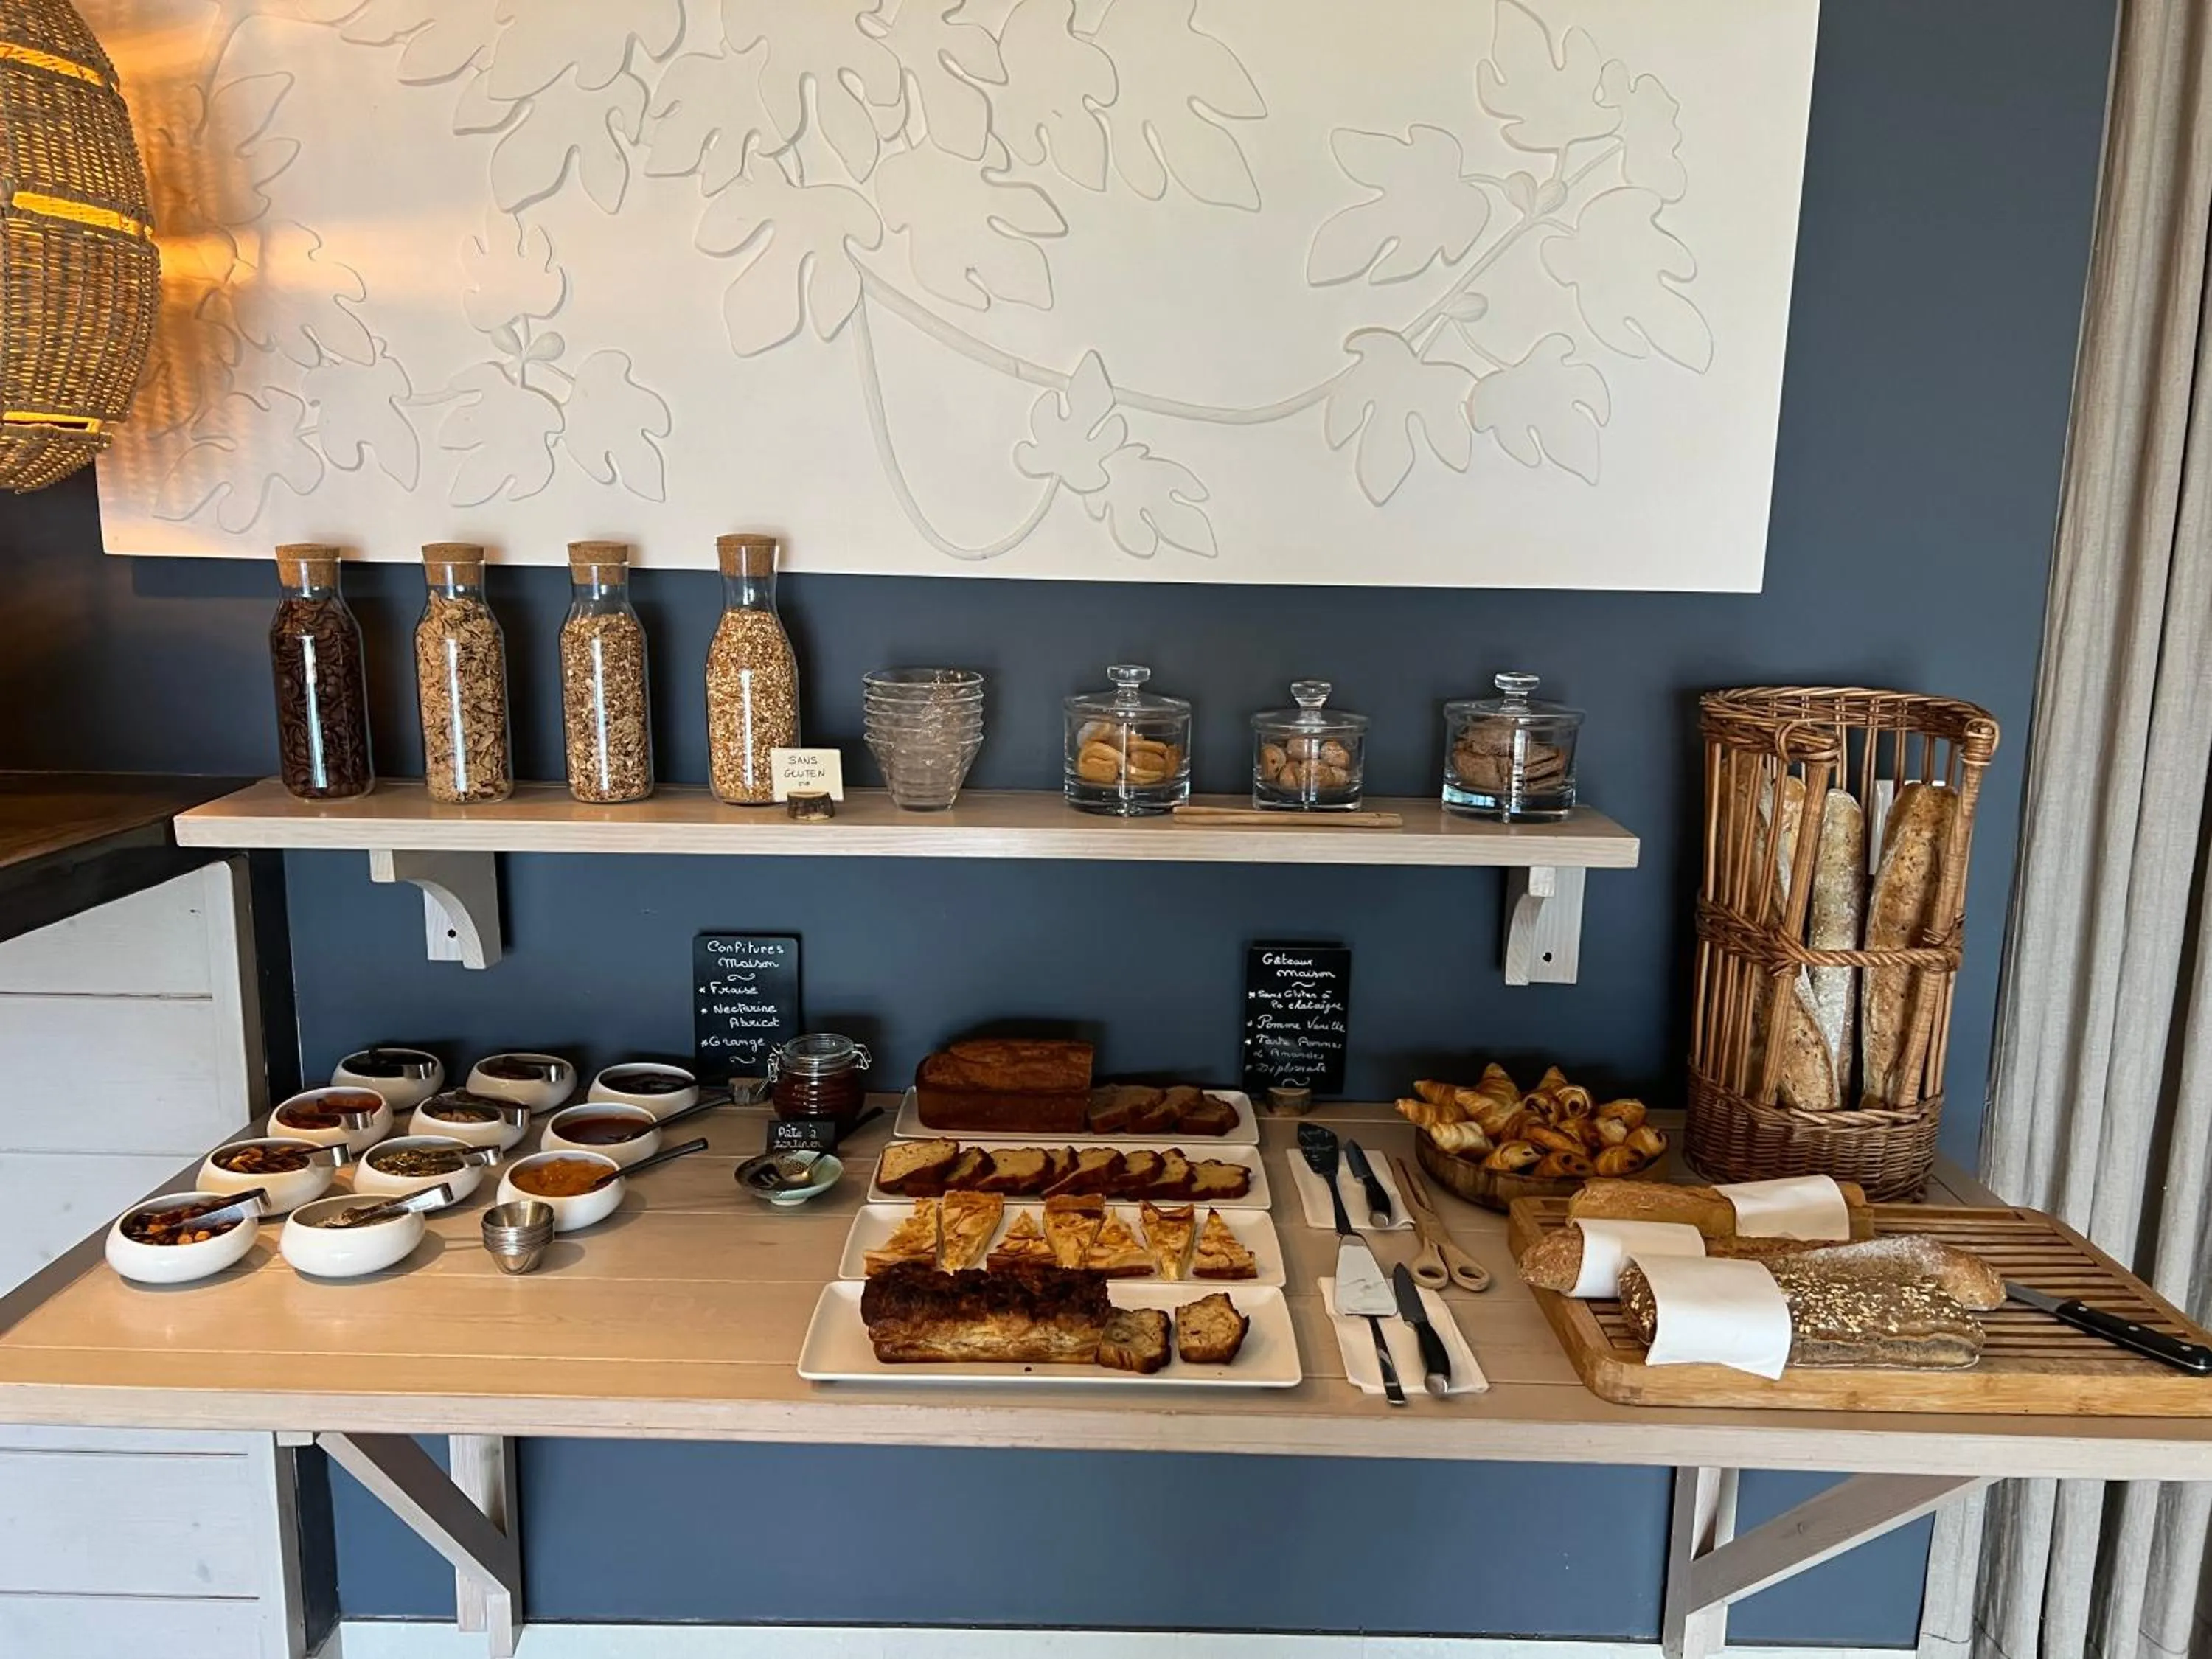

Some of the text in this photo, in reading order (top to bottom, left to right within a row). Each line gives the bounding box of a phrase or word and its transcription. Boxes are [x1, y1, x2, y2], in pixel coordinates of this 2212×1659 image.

[788, 755, 818, 765] SANS
[784, 769, 825, 778] GLUTEN
[707, 940, 785, 954] Confitures
[709, 981, 759, 995] Fraise
[713, 1001, 778, 1014] Nectarine
[729, 1017, 780, 1029] Abricot
[1256, 1014, 1346, 1033] Pomme Vanille
